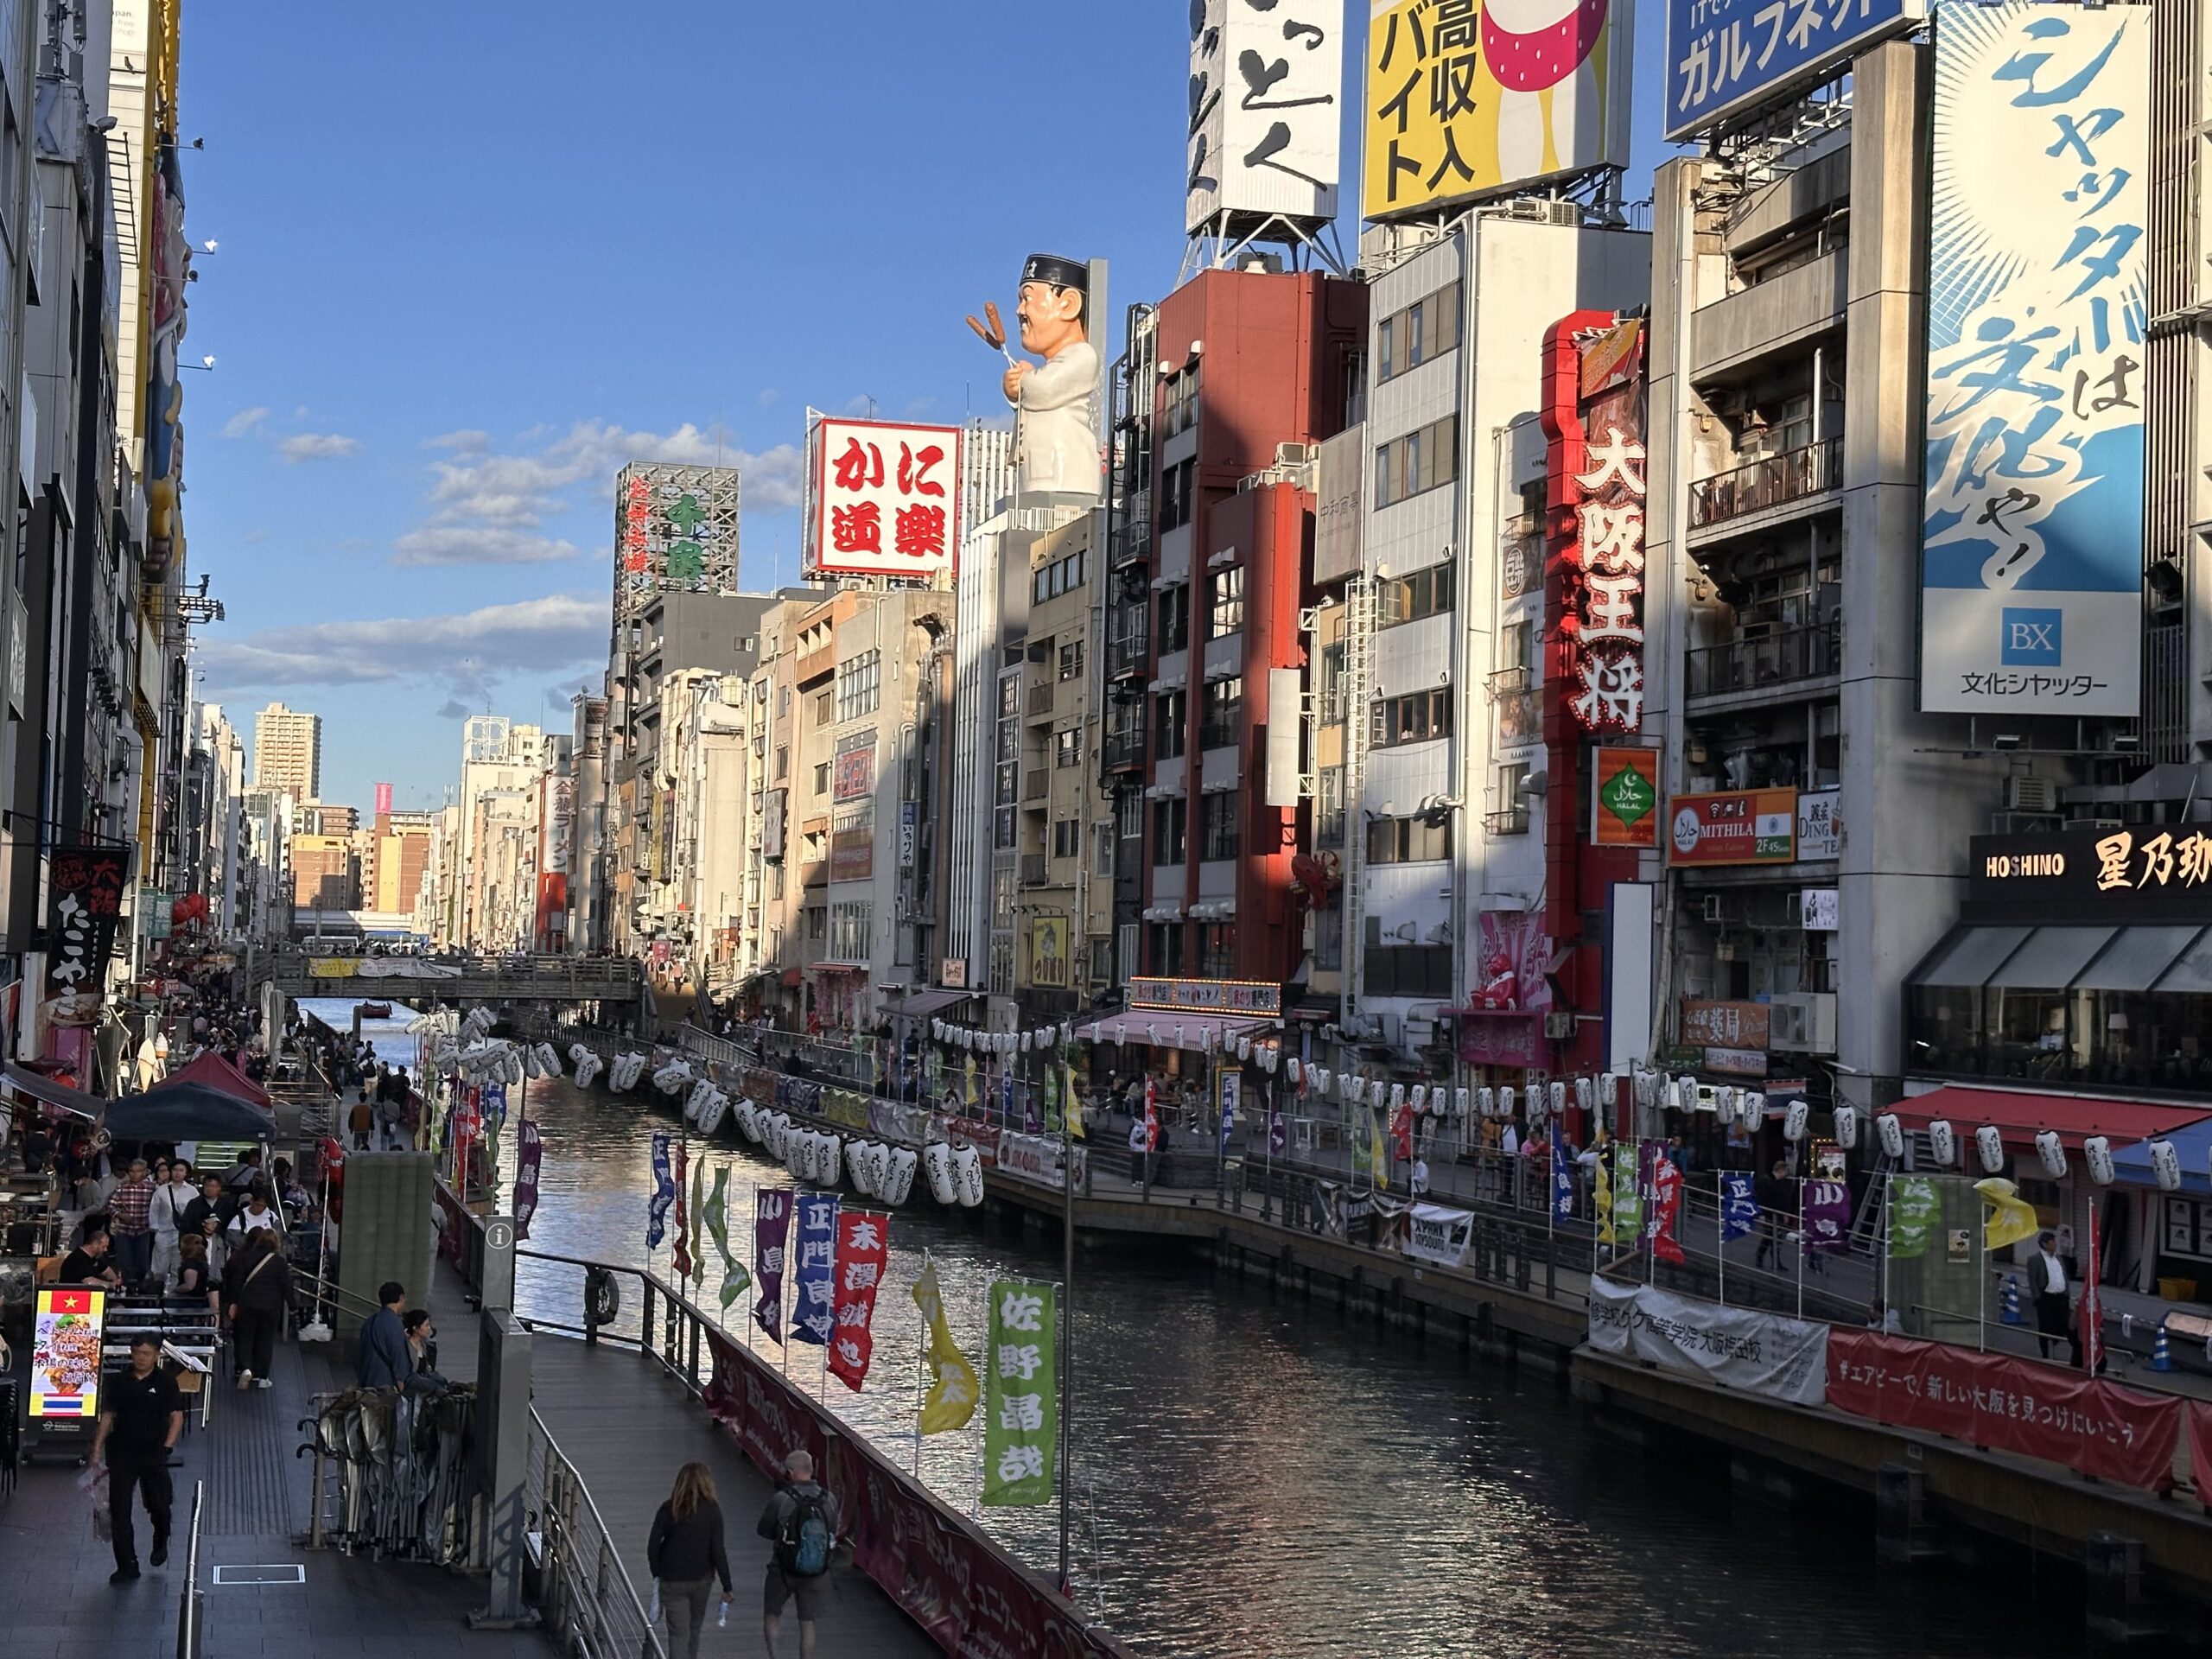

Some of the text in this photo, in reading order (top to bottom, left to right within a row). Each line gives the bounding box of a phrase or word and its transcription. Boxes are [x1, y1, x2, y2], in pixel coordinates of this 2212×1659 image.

[1238, 0, 1333, 192] っとく
[1377, 0, 1429, 203] バイト
[1428, 0, 1477, 193] 高収入
[832, 436, 945, 499] かに
[1574, 428, 1646, 731] 大阪王将
[2009, 623, 2055, 652] BX
[1613, 785, 1643, 802] حلال
[1617, 802, 1641, 810] HALAL
[902, 826, 913, 865] いろりや
[1700, 823, 1754, 838] MITHILA
[1756, 838, 1769, 854] 2F
[1799, 817, 1829, 838] DING
[1986, 853, 2065, 878] HOSHINO
[52, 893, 90, 1016] たこやき
[1709, 1007, 1740, 1043] 薬局
[997, 1290, 1044, 1483] 佐野晶哉
